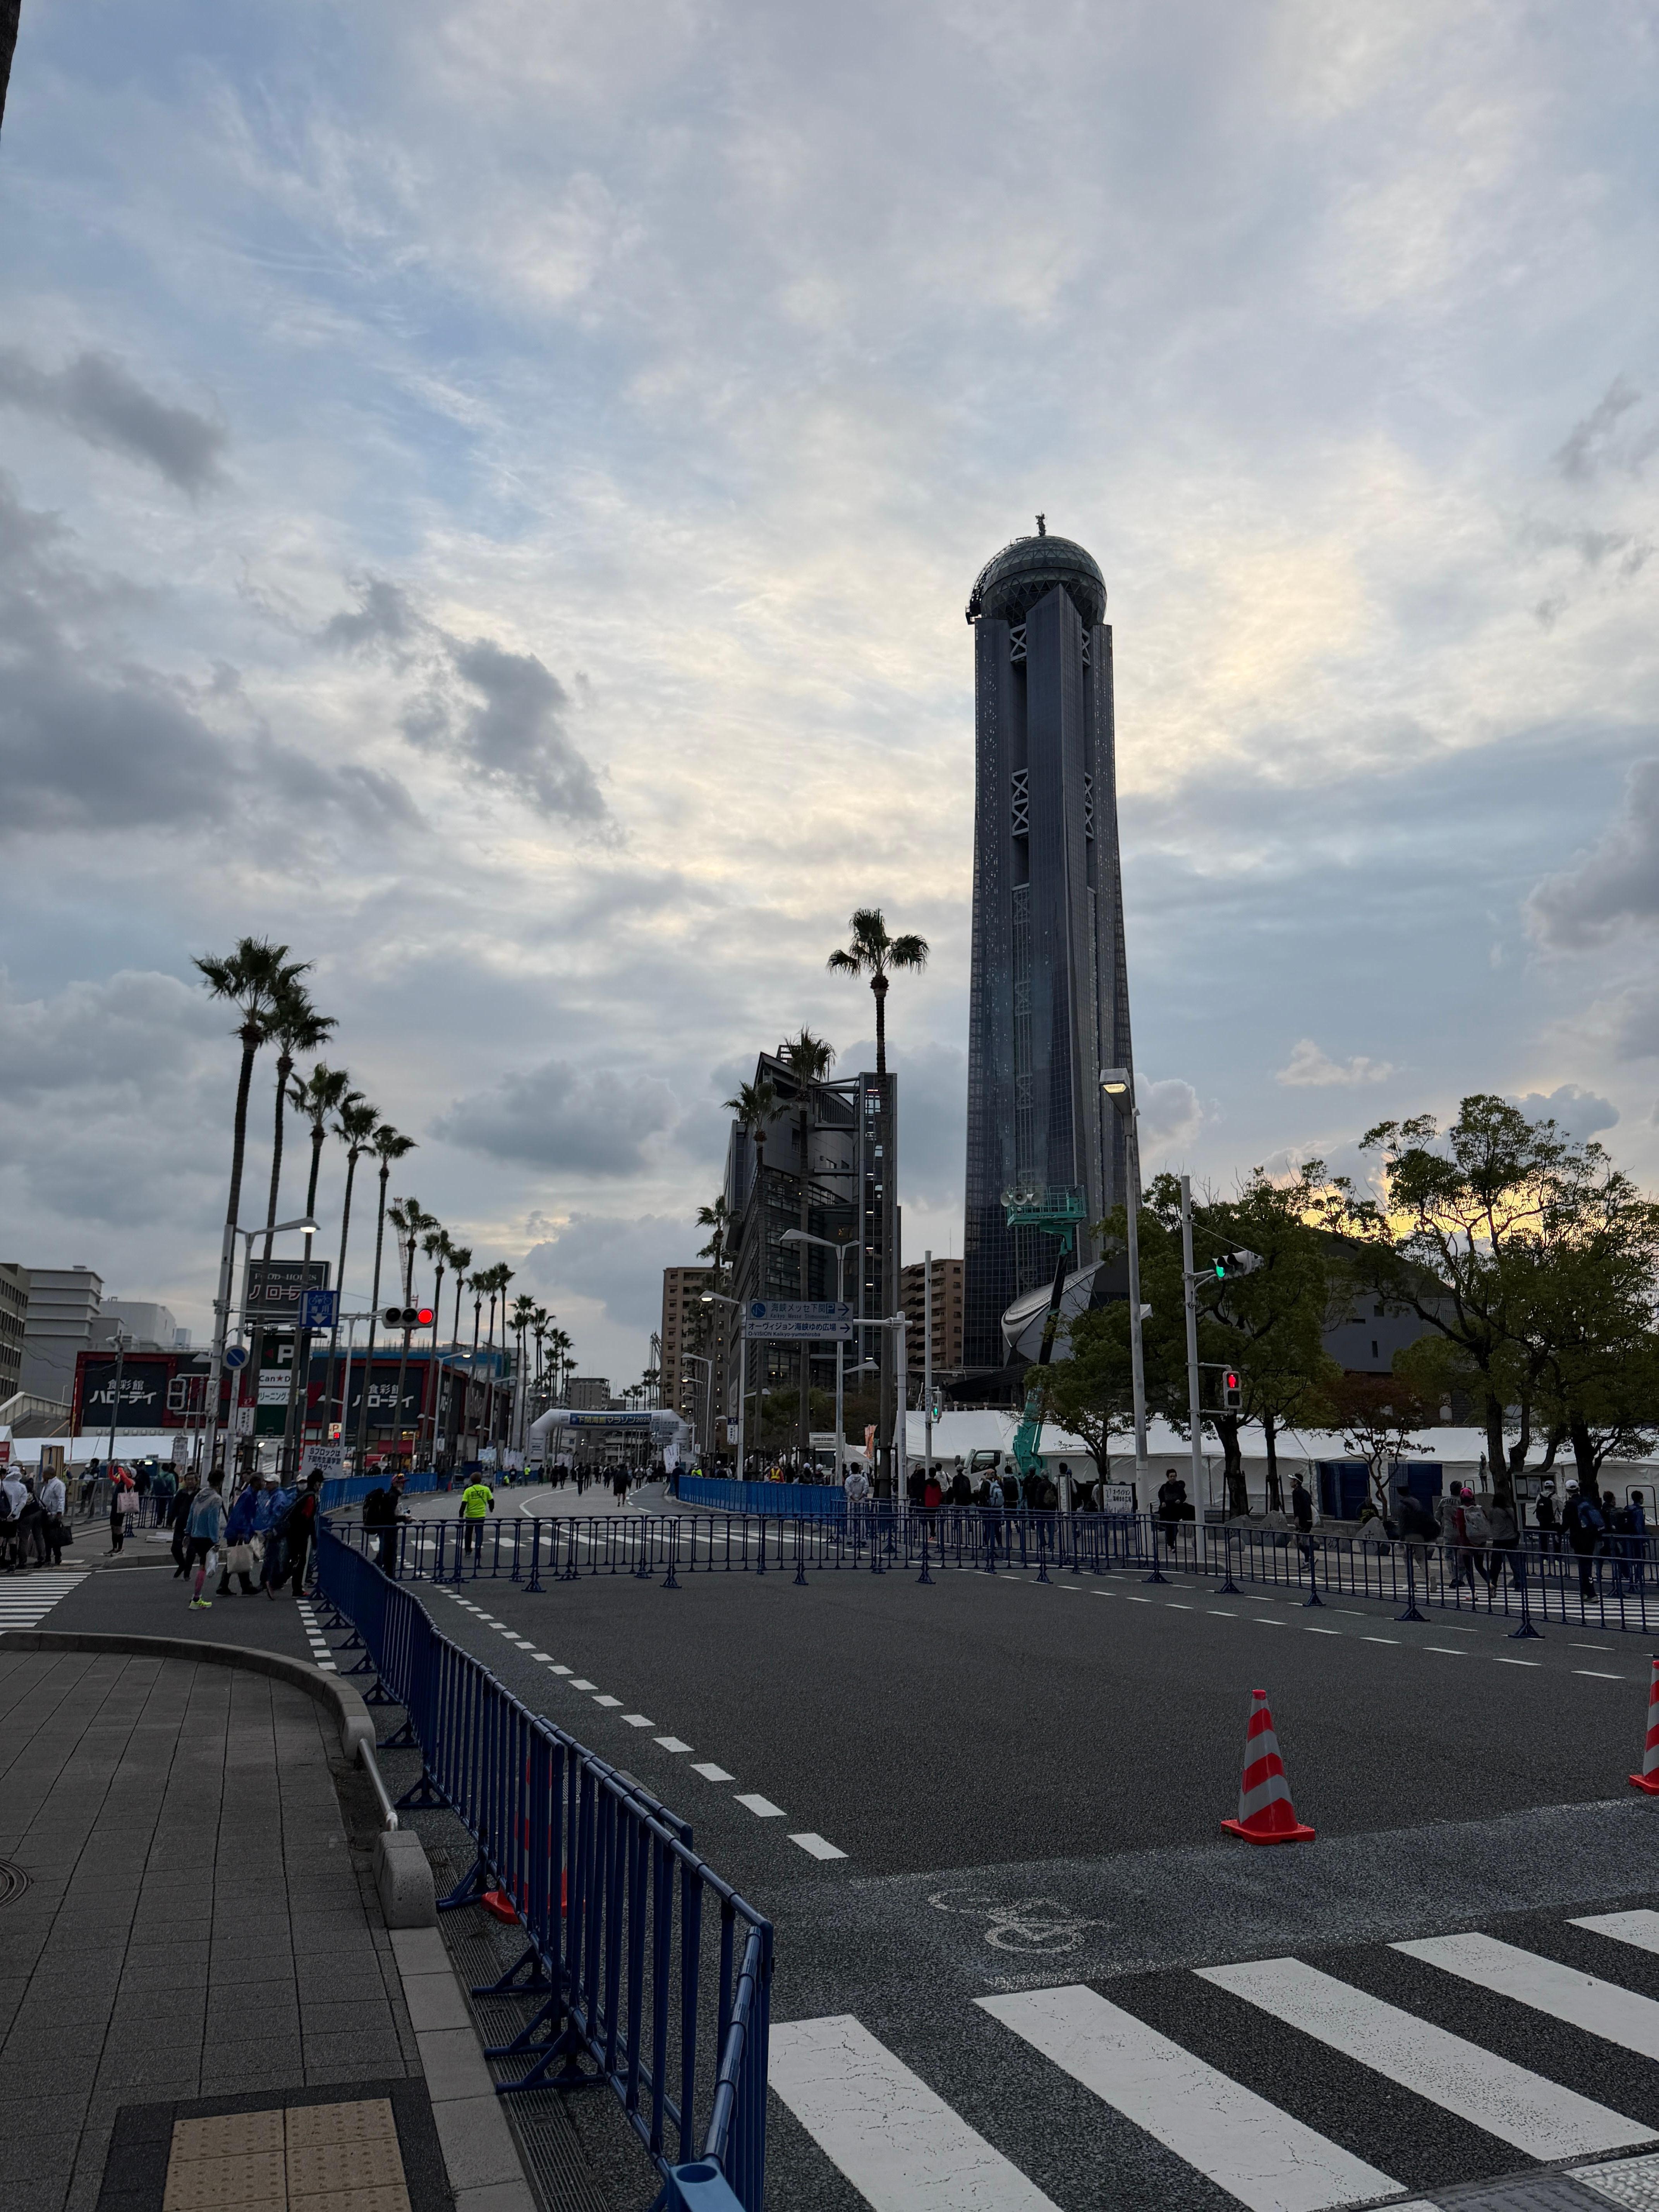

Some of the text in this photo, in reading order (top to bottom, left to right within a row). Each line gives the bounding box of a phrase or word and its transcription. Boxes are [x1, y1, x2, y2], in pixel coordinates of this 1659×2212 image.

[771, 1302, 826, 1313] 海峡メッセ下関
[749, 1322, 836, 1331] オーヴィジョン海峡ゆめ広場
[277, 1345, 294, 1363] P
[107, 1379, 144, 1391] 食彩館
